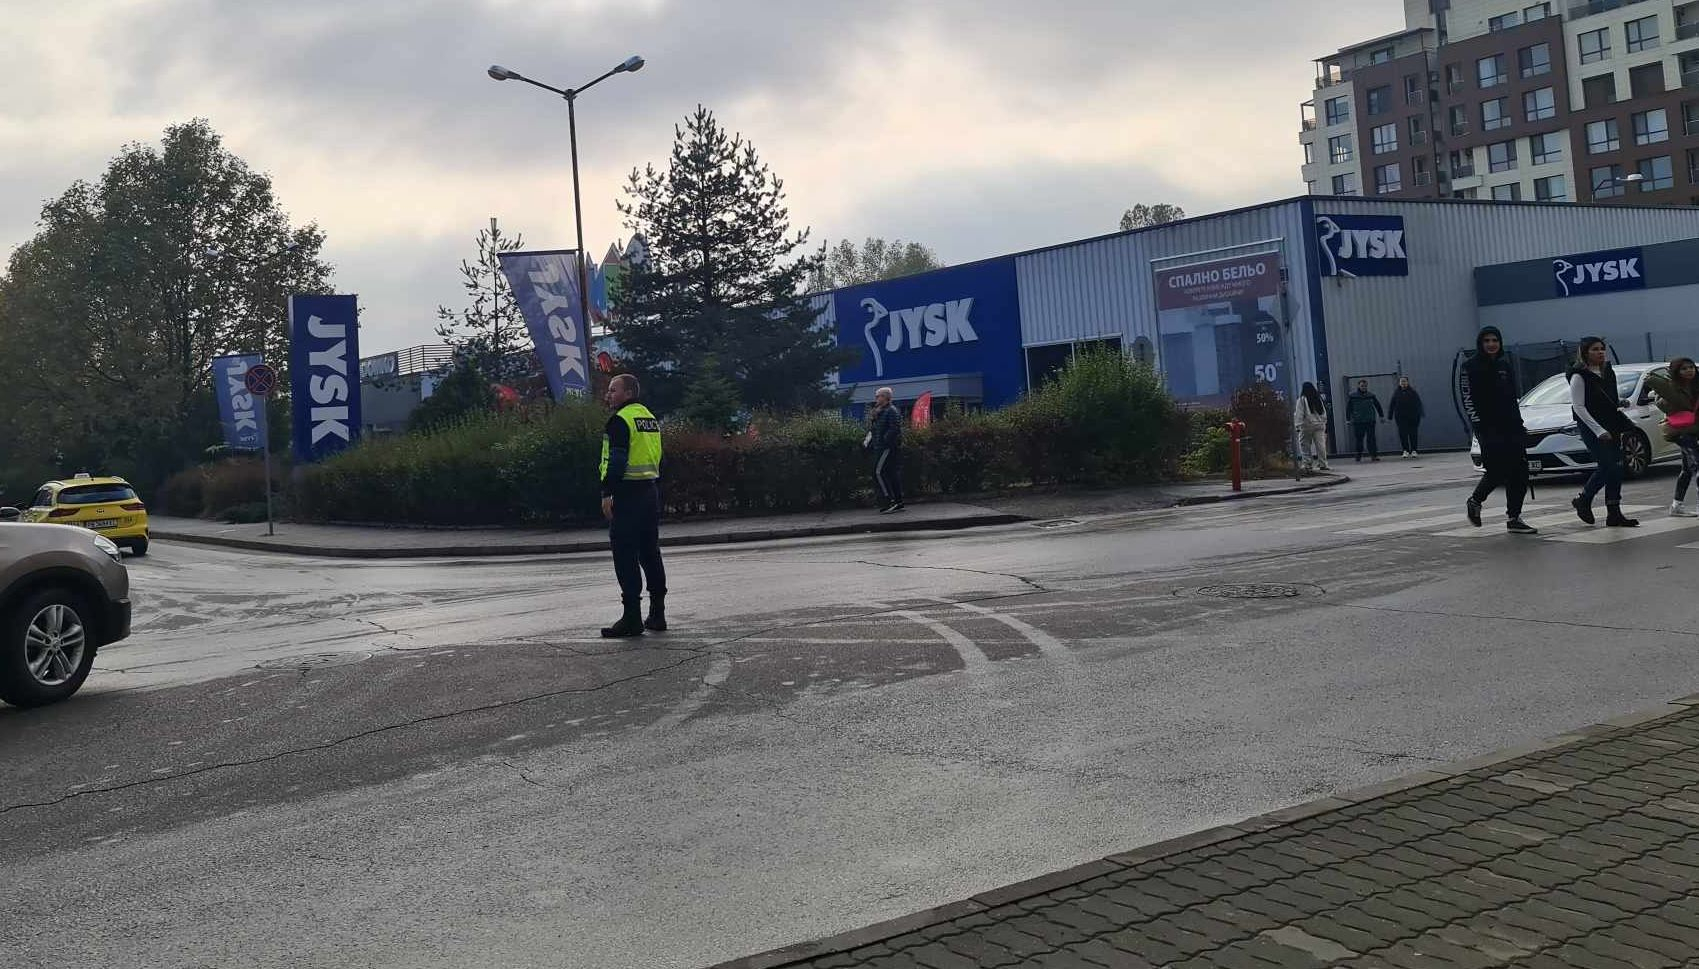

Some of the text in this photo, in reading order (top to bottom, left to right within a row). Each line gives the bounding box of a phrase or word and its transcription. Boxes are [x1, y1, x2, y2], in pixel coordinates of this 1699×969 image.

[1338, 229, 1408, 259] JYSK
[1168, 269, 1220, 288] СПАЛНО
[1222, 262, 1266, 280] БЕЛЬО
[1573, 257, 1641, 284] JYSK
[885, 297, 979, 352] JYSK
[1256, 331, 1275, 344] 50%
[307, 314, 350, 445] JYSK
